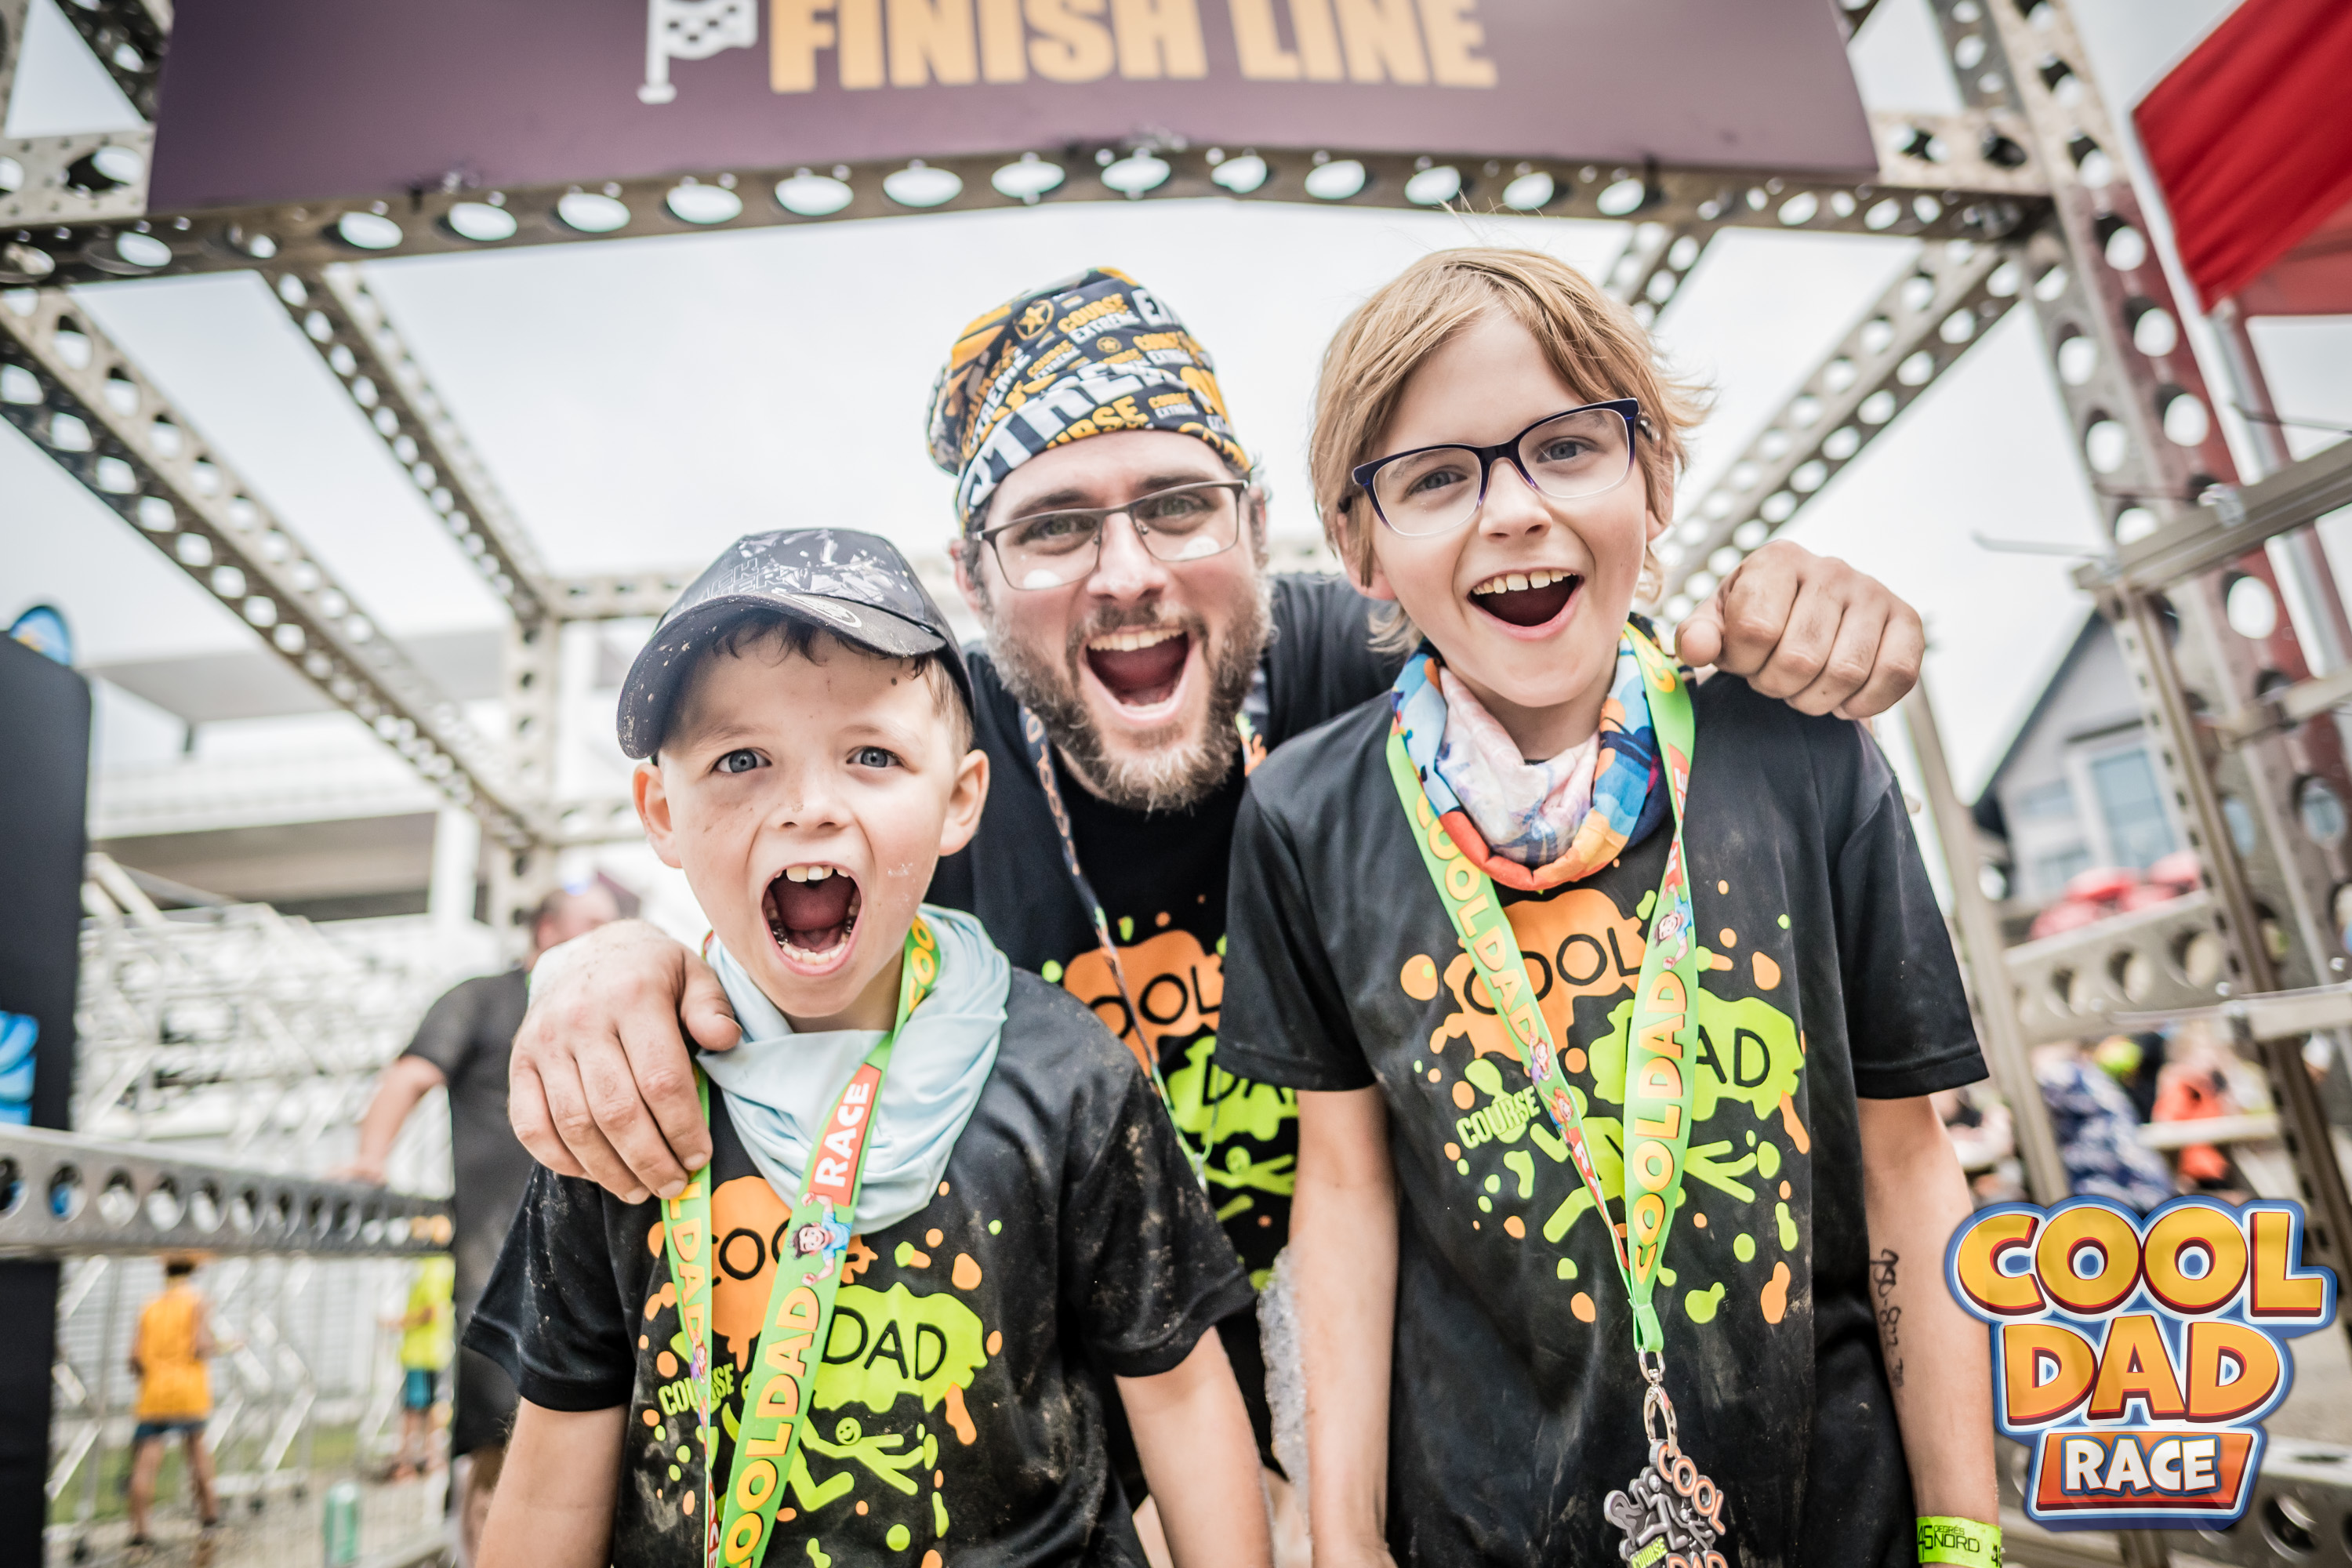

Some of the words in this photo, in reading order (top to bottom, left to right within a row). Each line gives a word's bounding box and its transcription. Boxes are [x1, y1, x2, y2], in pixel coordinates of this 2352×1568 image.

[769, 0, 1207, 93] FINISH
[1226, 0, 1498, 89] LINE
[1090, 965, 1220, 1040] OOL
[815, 1082, 870, 1189] RACE
[1457, 1085, 1541, 1149] COURSE
[821, 1305, 948, 1382] DAD
[1632, 1537, 1668, 1568] COURSE
[1918, 1525, 1933, 1560] 45
[1934, 1533, 1980, 1553] NORD
